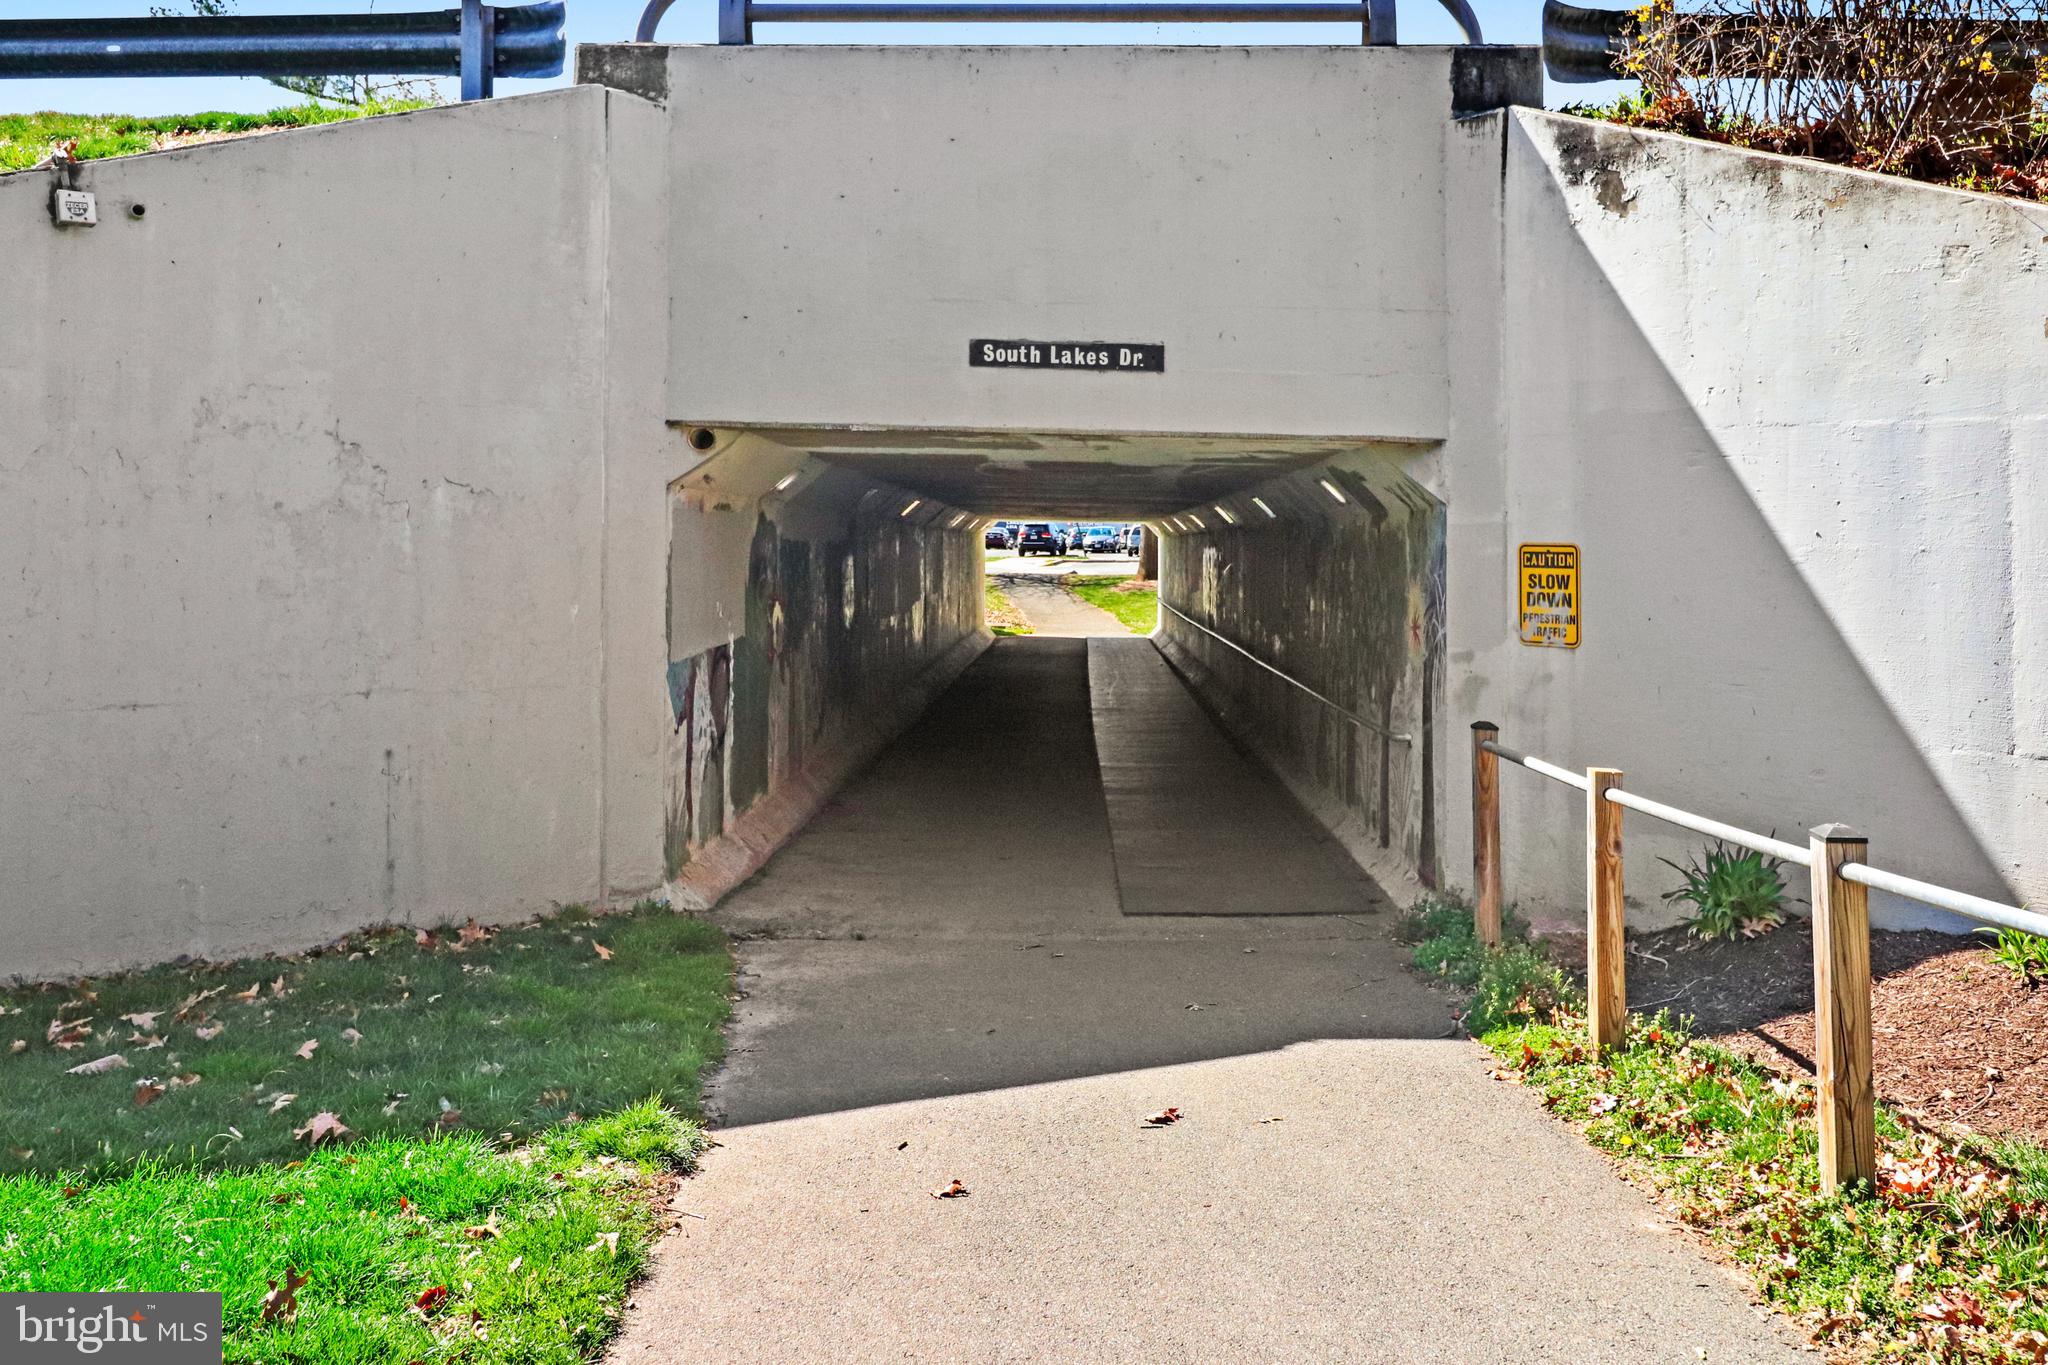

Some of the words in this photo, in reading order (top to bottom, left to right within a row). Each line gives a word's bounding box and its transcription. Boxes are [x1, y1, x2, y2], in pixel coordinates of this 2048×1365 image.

[983, 344, 1040, 363] South
[1050, 345, 1109, 366] Lakes
[1119, 348, 1144, 367] Dr.
[1524, 553, 1574, 567] CAUTION
[1528, 573, 1570, 590] SLOW
[1526, 591, 1572, 608] DOWN
[1523, 612, 1576, 625] PEDESTRIAN
